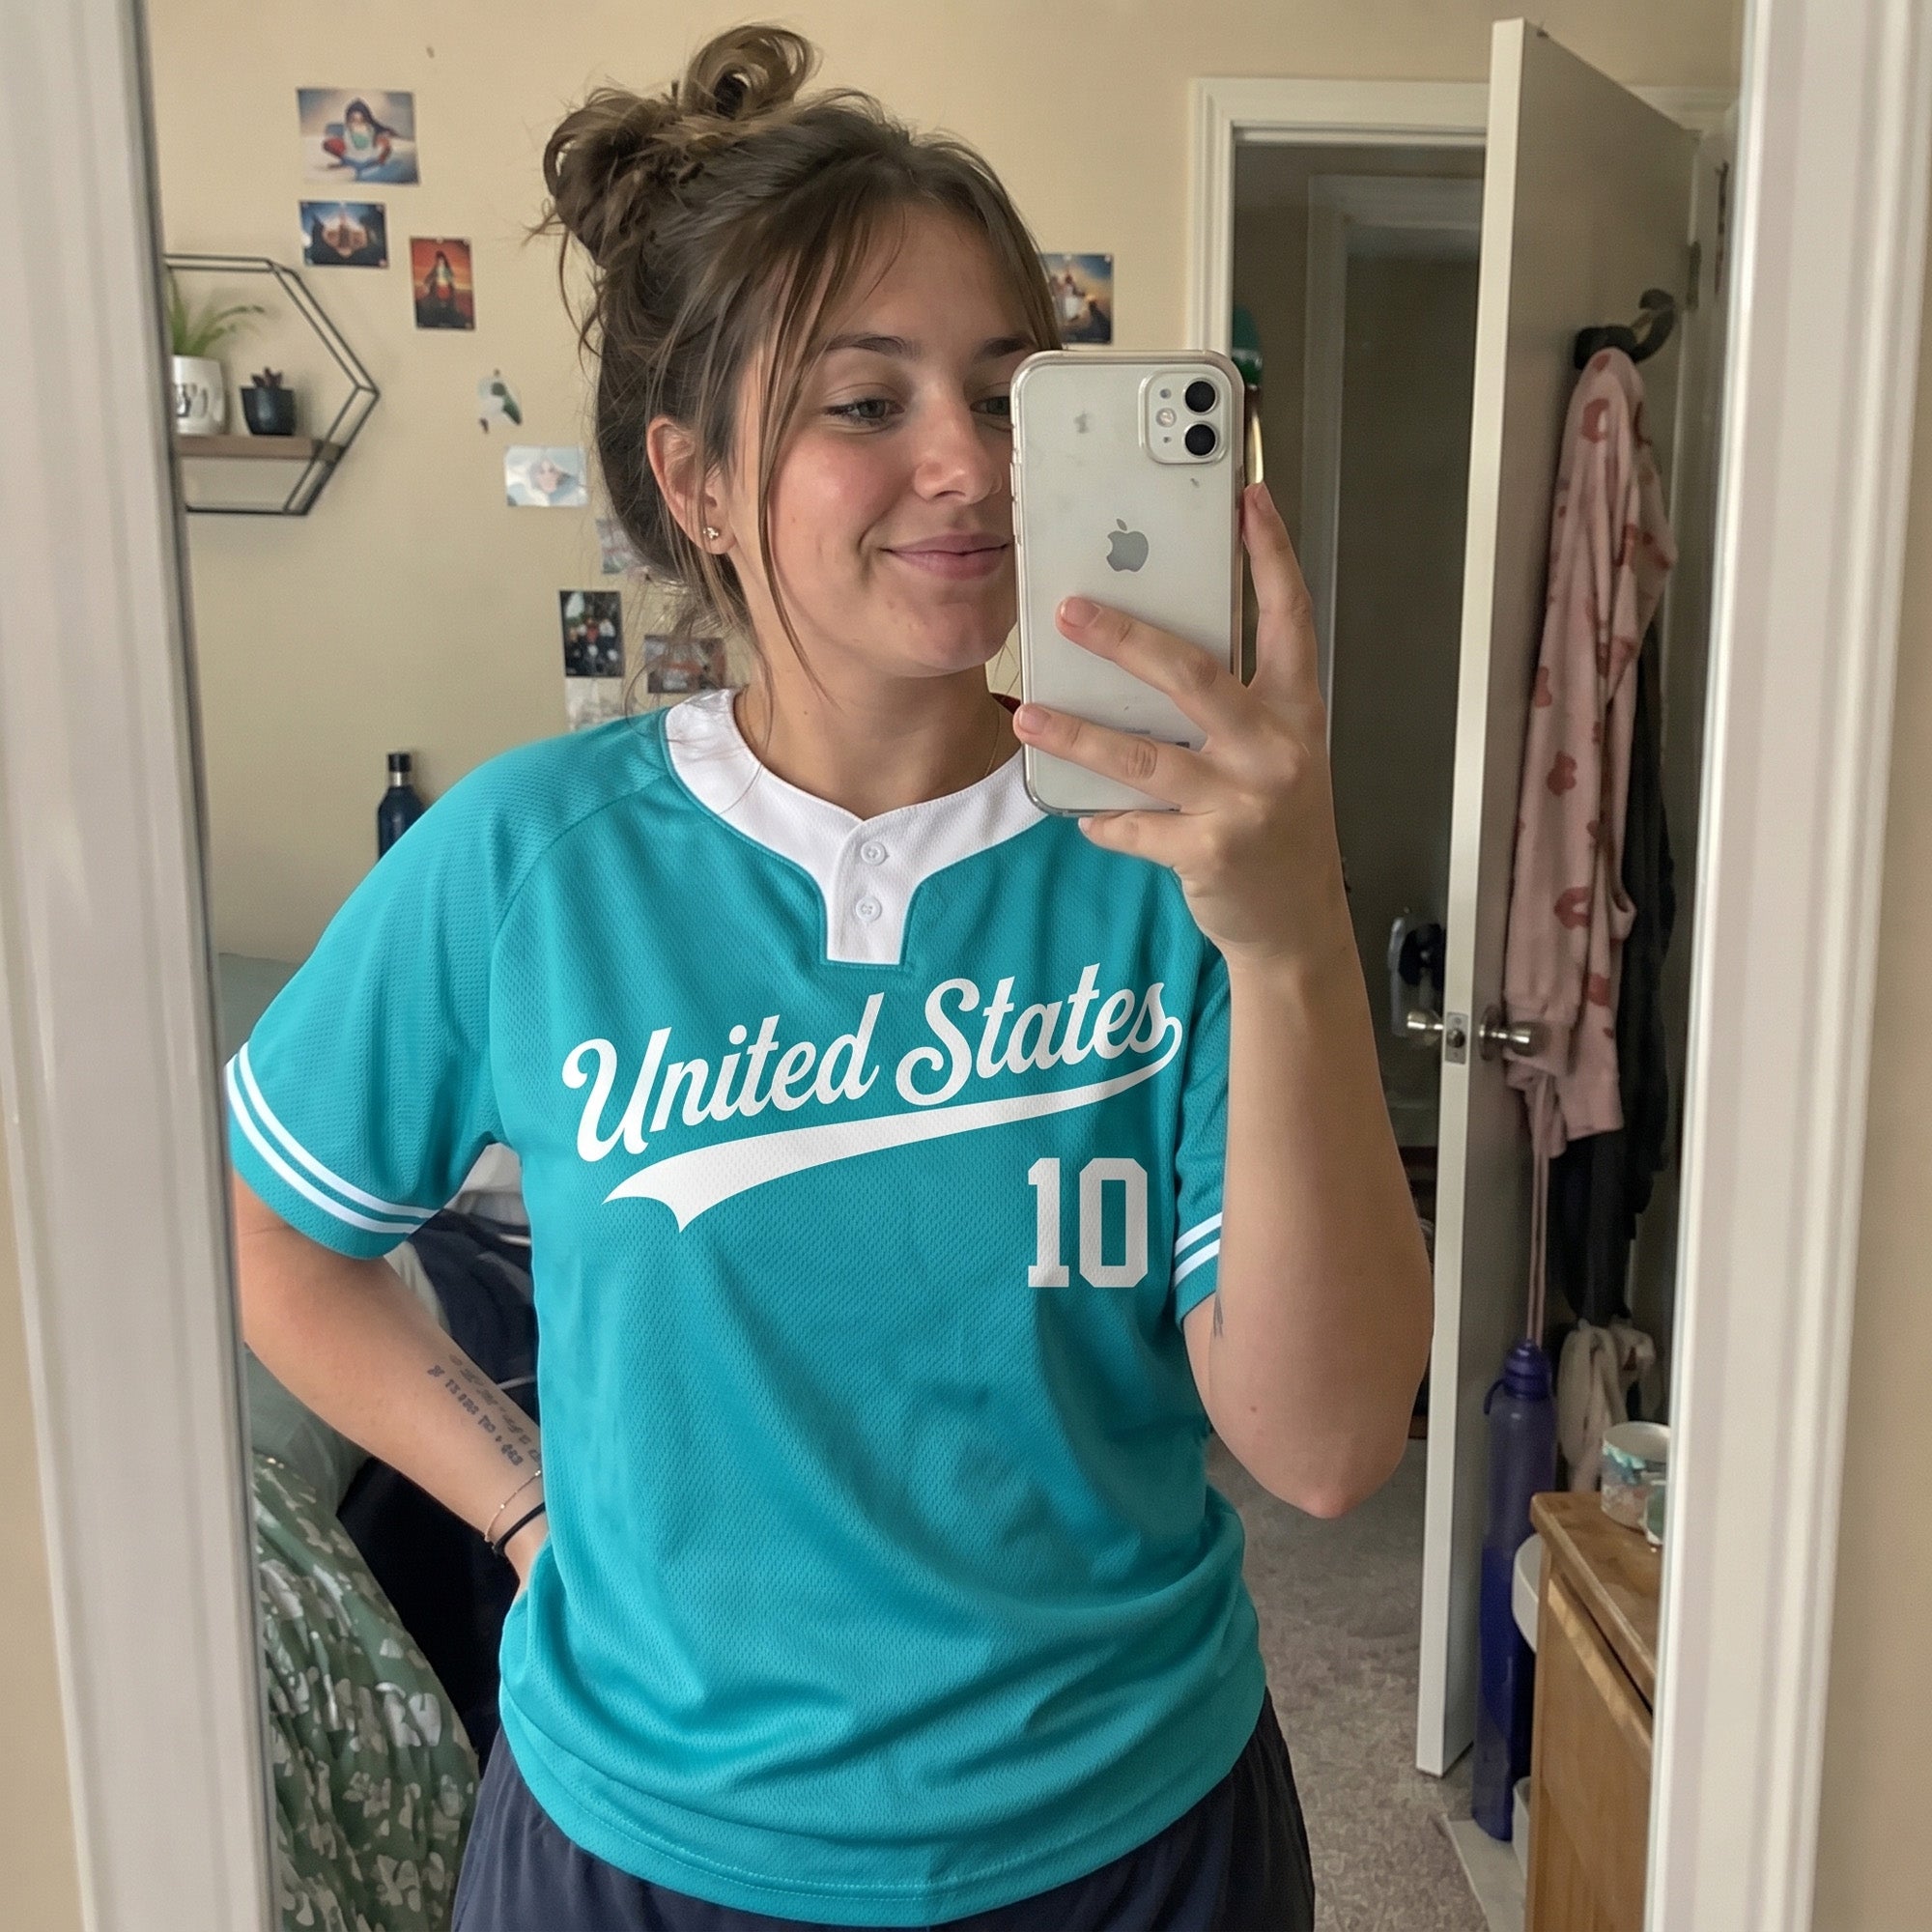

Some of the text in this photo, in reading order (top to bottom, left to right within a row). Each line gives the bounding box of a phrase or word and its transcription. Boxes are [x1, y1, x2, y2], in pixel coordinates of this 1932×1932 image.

[562, 963, 1183, 1162] United States
[1028, 1157, 1149, 1288] 10
